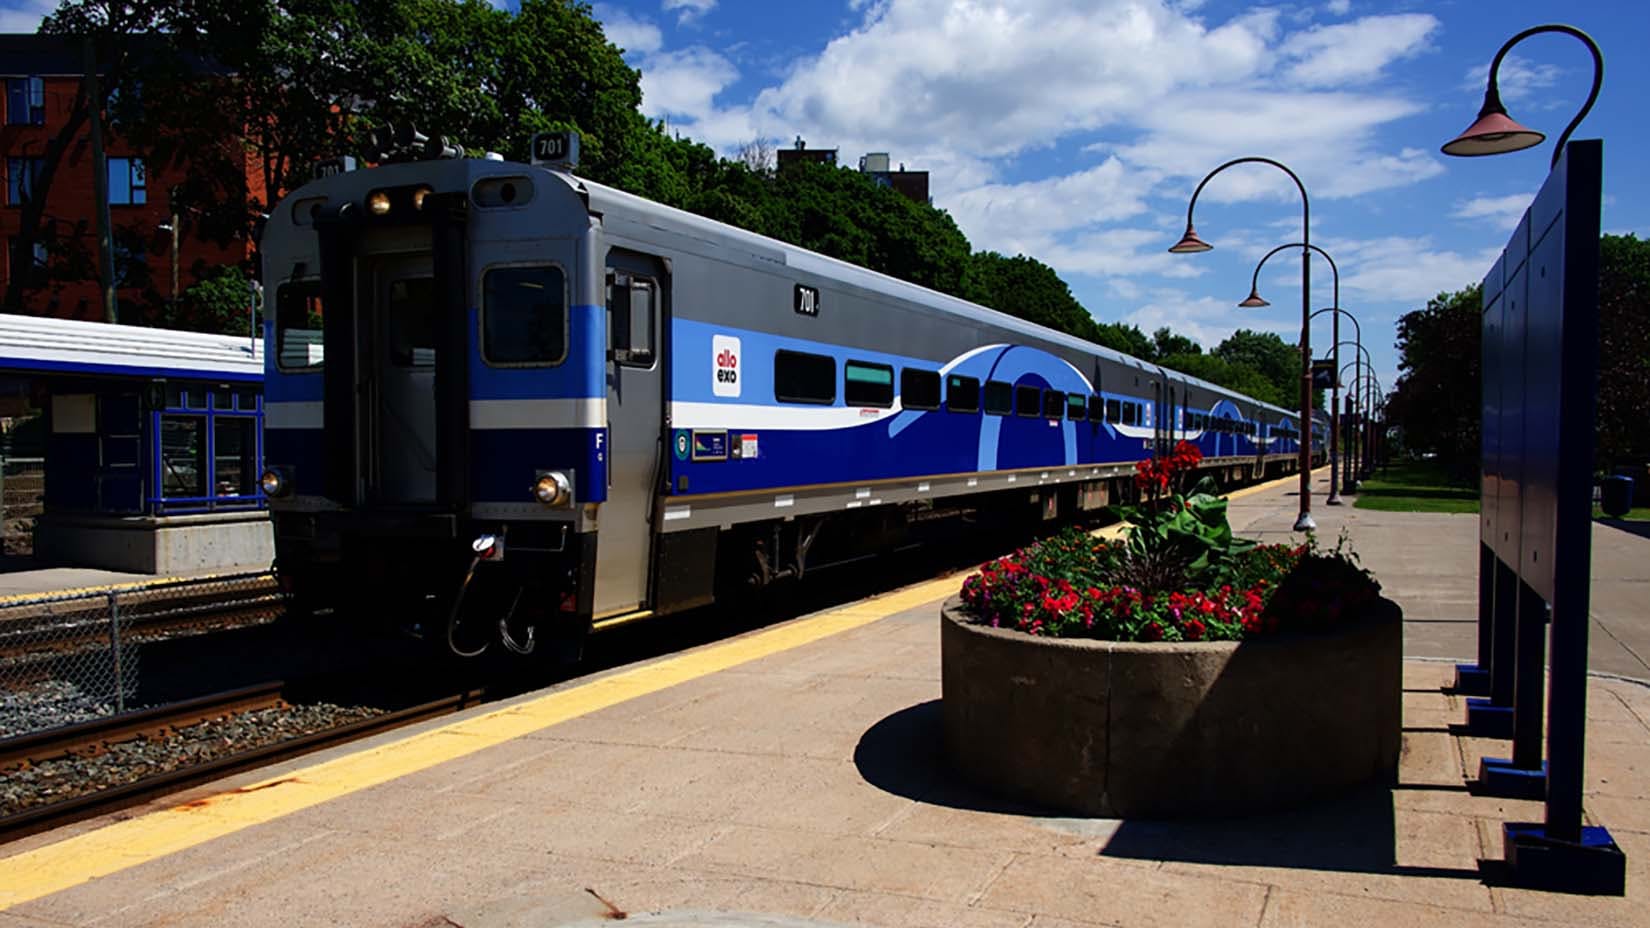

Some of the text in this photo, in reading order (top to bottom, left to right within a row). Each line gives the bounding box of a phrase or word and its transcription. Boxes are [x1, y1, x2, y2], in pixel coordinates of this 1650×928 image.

[540, 139, 562, 154] 701
[320, 165, 340, 177] 701
[800, 287, 814, 313] 701
[717, 349, 737, 368] allo
[717, 369, 737, 384] exo
[596, 433, 604, 449] F
